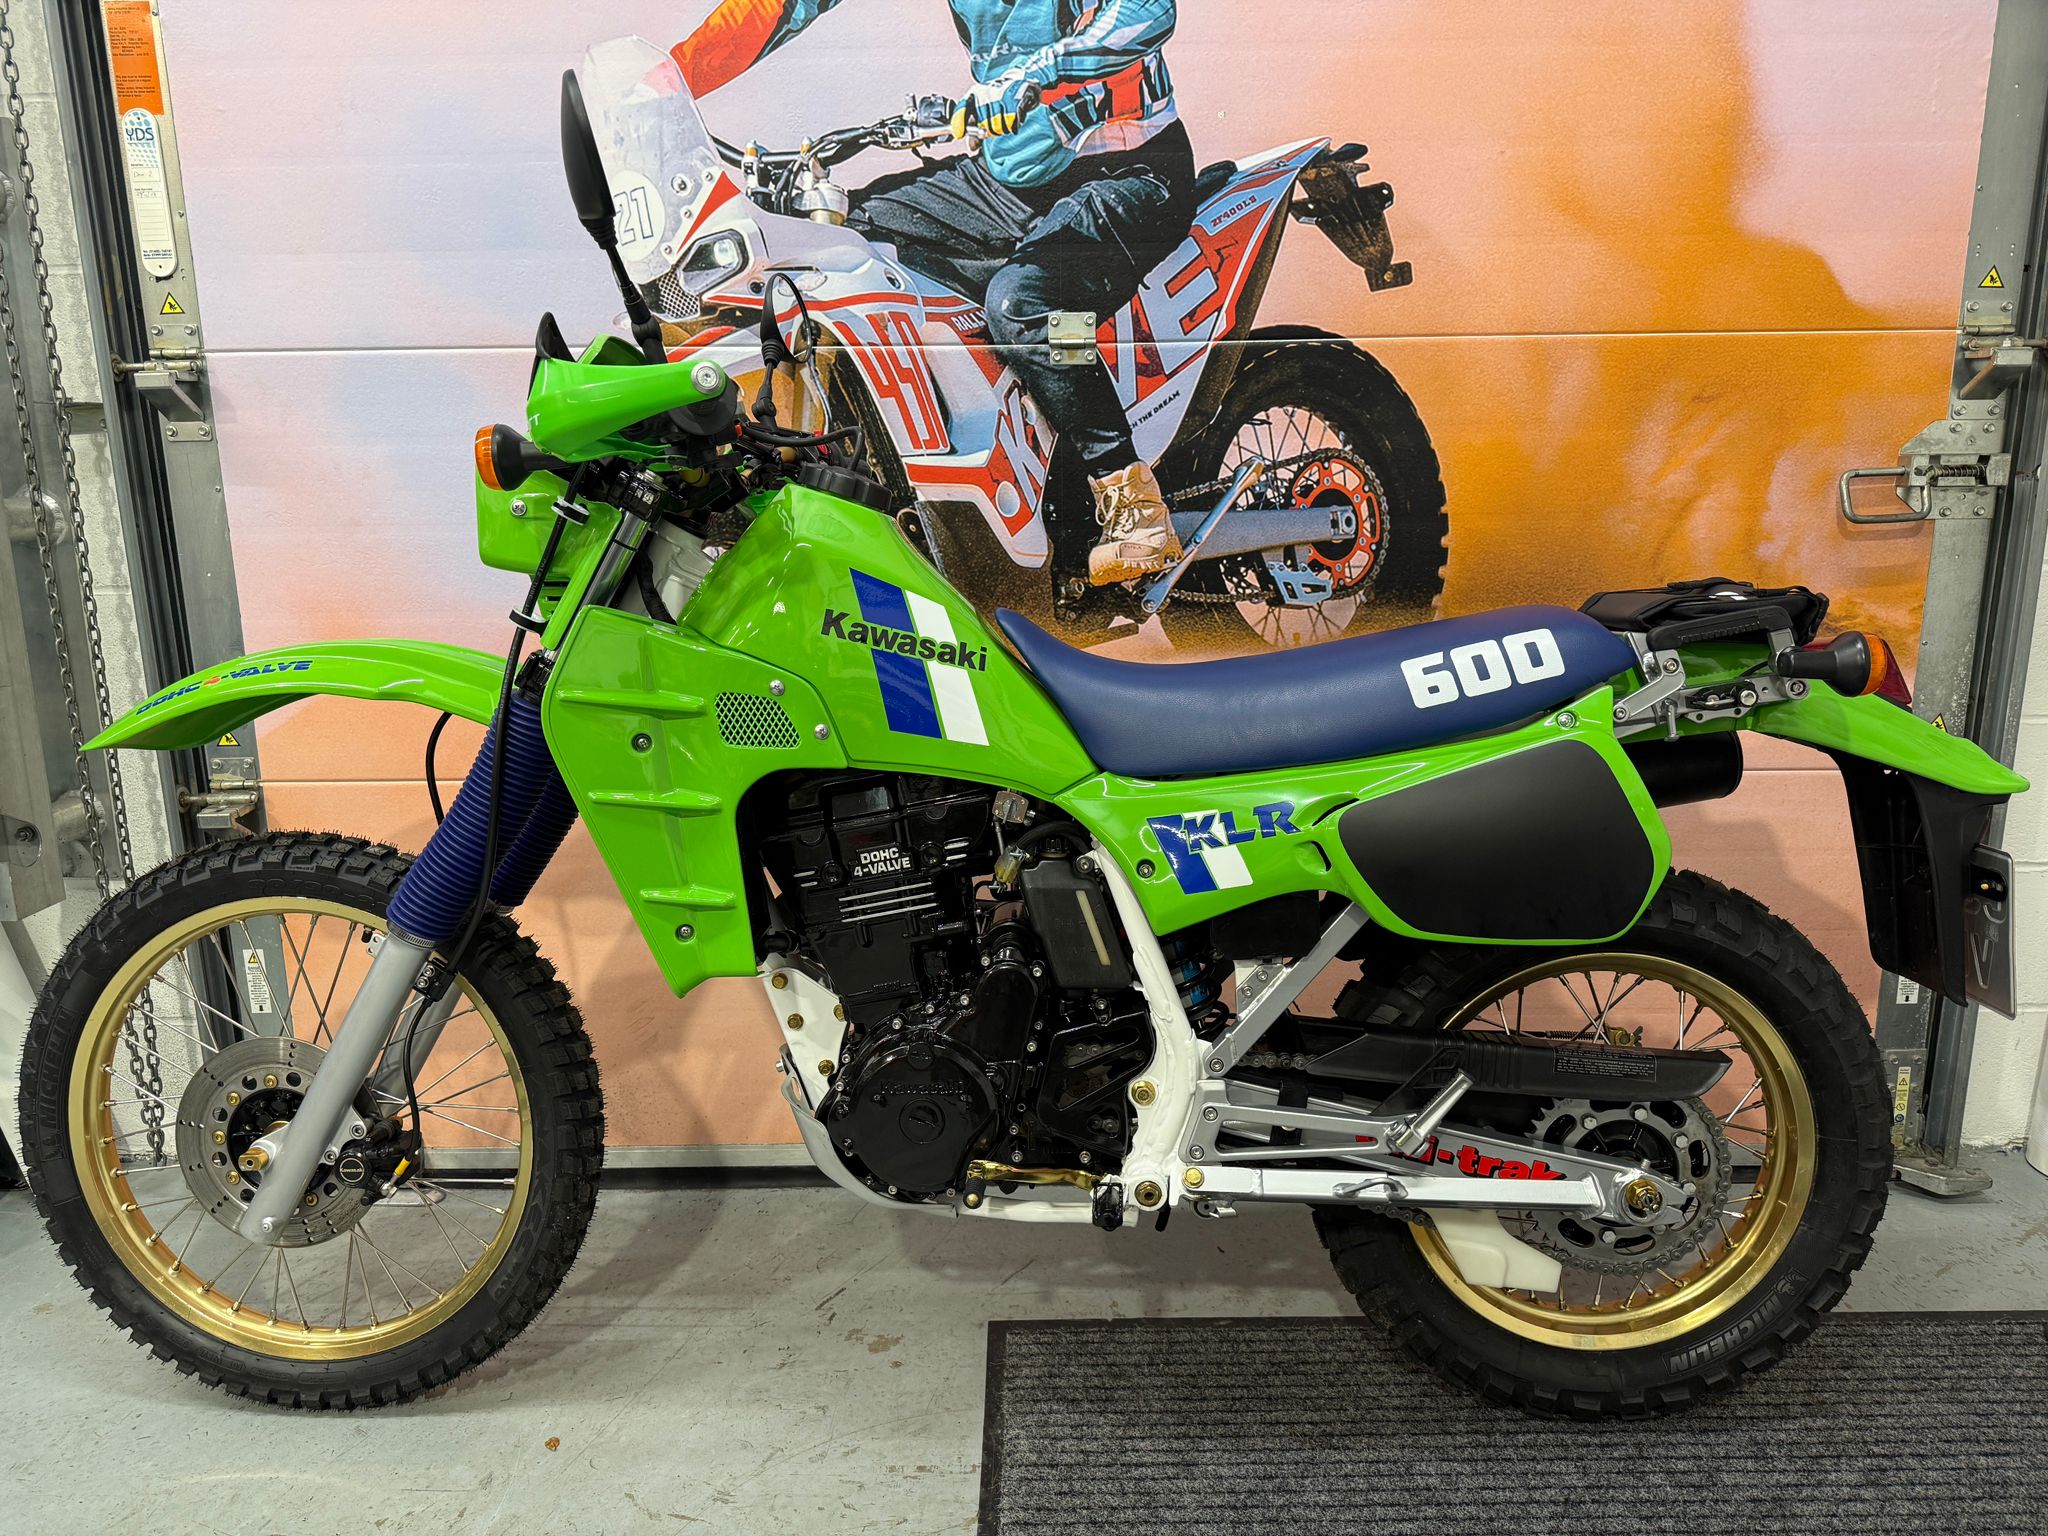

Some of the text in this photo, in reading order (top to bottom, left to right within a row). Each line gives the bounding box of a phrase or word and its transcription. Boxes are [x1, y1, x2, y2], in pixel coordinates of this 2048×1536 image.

[125, 127, 155, 142] YDS
[612, 186, 654, 247] 21
[1137, 410, 1153, 424] THE
[1152, 390, 1180, 414] DREAM
[821, 608, 988, 672] Kawasaki
[1400, 628, 1566, 709] 600
[135, 680, 203, 716] DOHC
[1183, 800, 1302, 852] KLR
[854, 857, 911, 877] 4-VALVE
[860, 847, 899, 864] DOHC
[1670, 1294, 1784, 1375] MICHELIN
